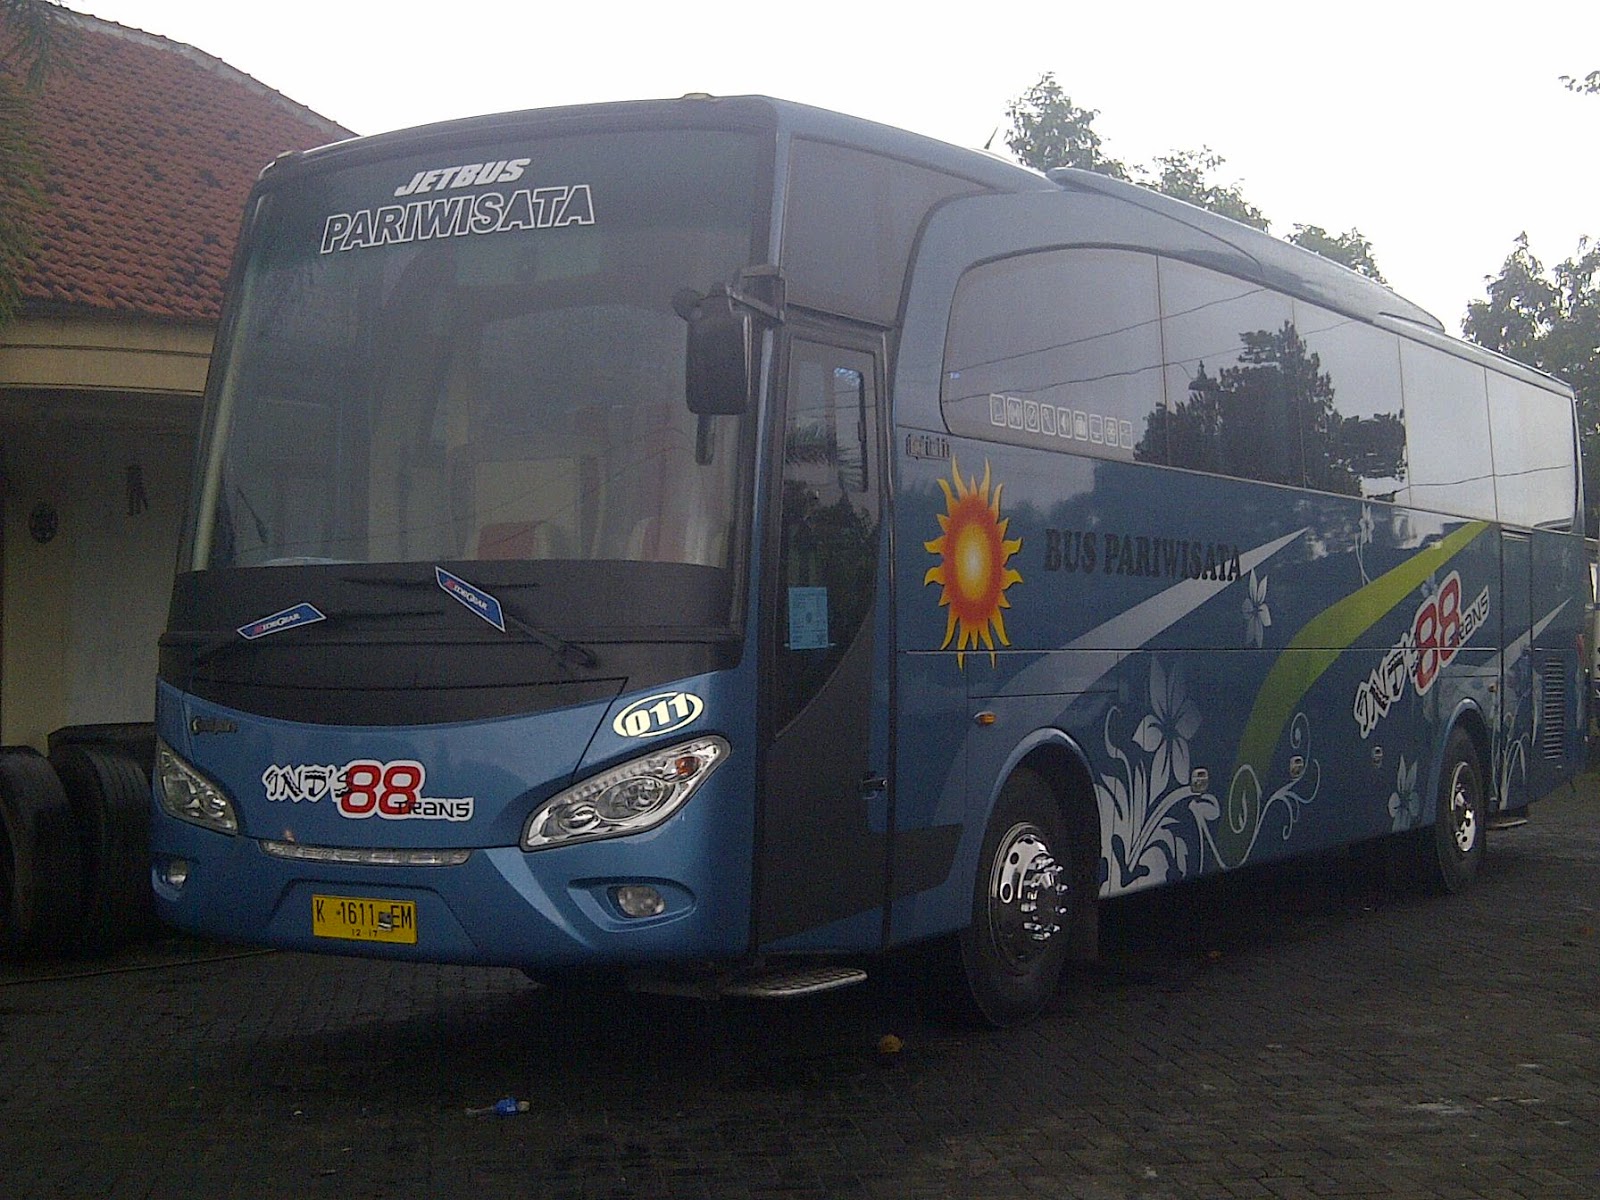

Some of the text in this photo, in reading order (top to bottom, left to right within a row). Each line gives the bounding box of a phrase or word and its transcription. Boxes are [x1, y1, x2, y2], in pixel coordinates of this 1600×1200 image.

[394, 158, 531, 196] JETBUS
[320, 184, 595, 254] PARIWISATA
[1044, 528, 1097, 574] BUS
[1414, 575, 1462, 691] 88
[624, 692, 690, 737] 011
[339, 762, 423, 818] 88
[316, 899, 413, 930] K 1611 EM
